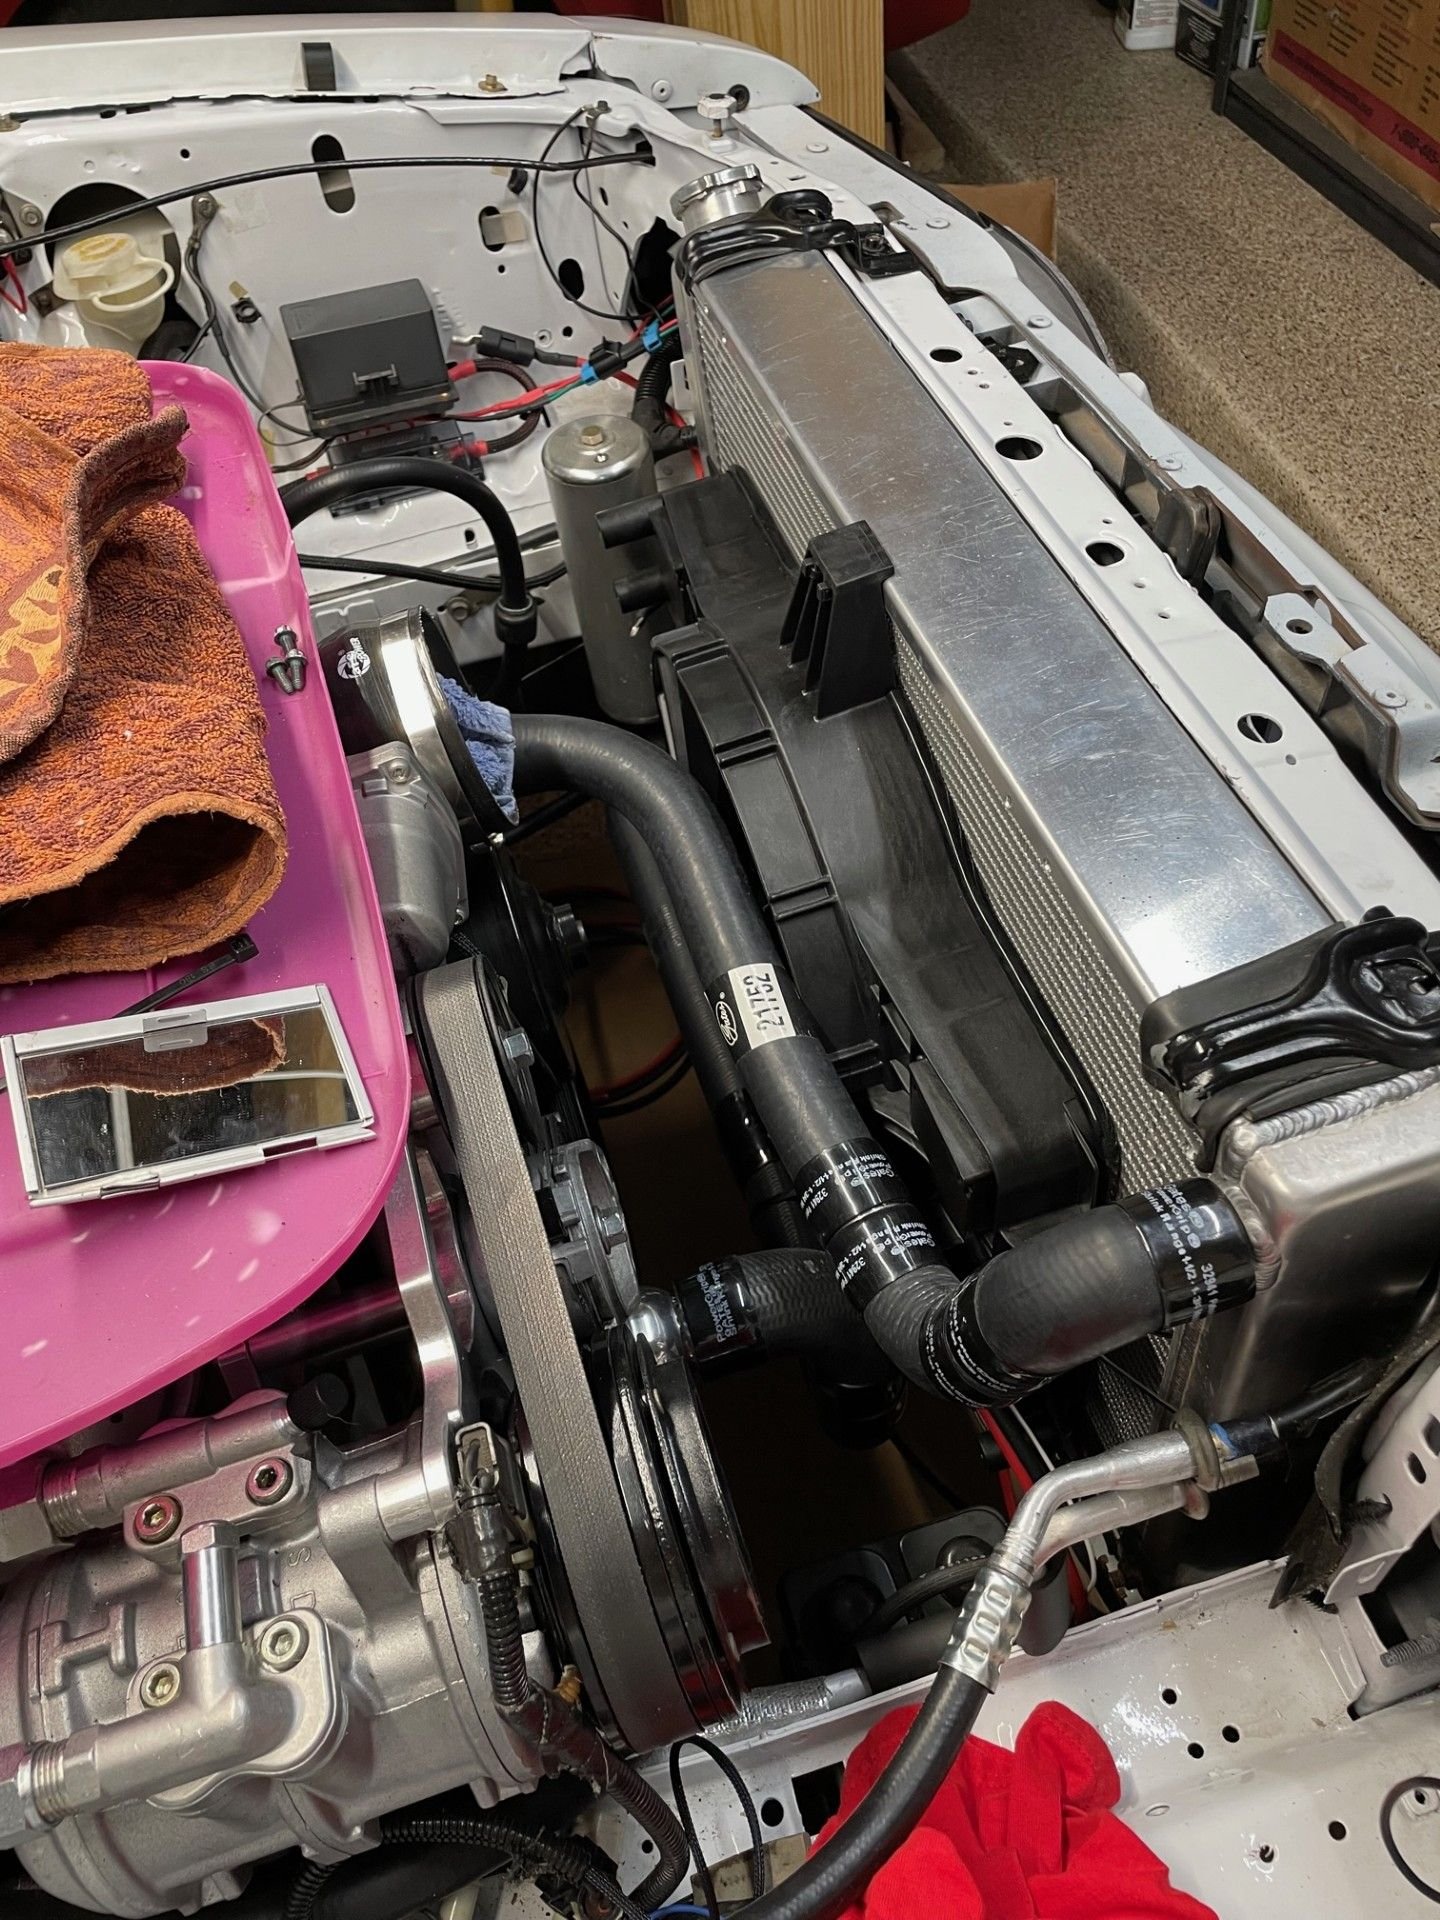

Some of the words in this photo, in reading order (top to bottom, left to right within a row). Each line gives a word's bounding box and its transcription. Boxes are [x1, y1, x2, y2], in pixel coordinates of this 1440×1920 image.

[743, 973, 784, 1031] 21752
[717, 1003, 738, 1046] Gates
[862, 1166, 894, 1178] Gates
[904, 1237, 935, 1249] Gates
